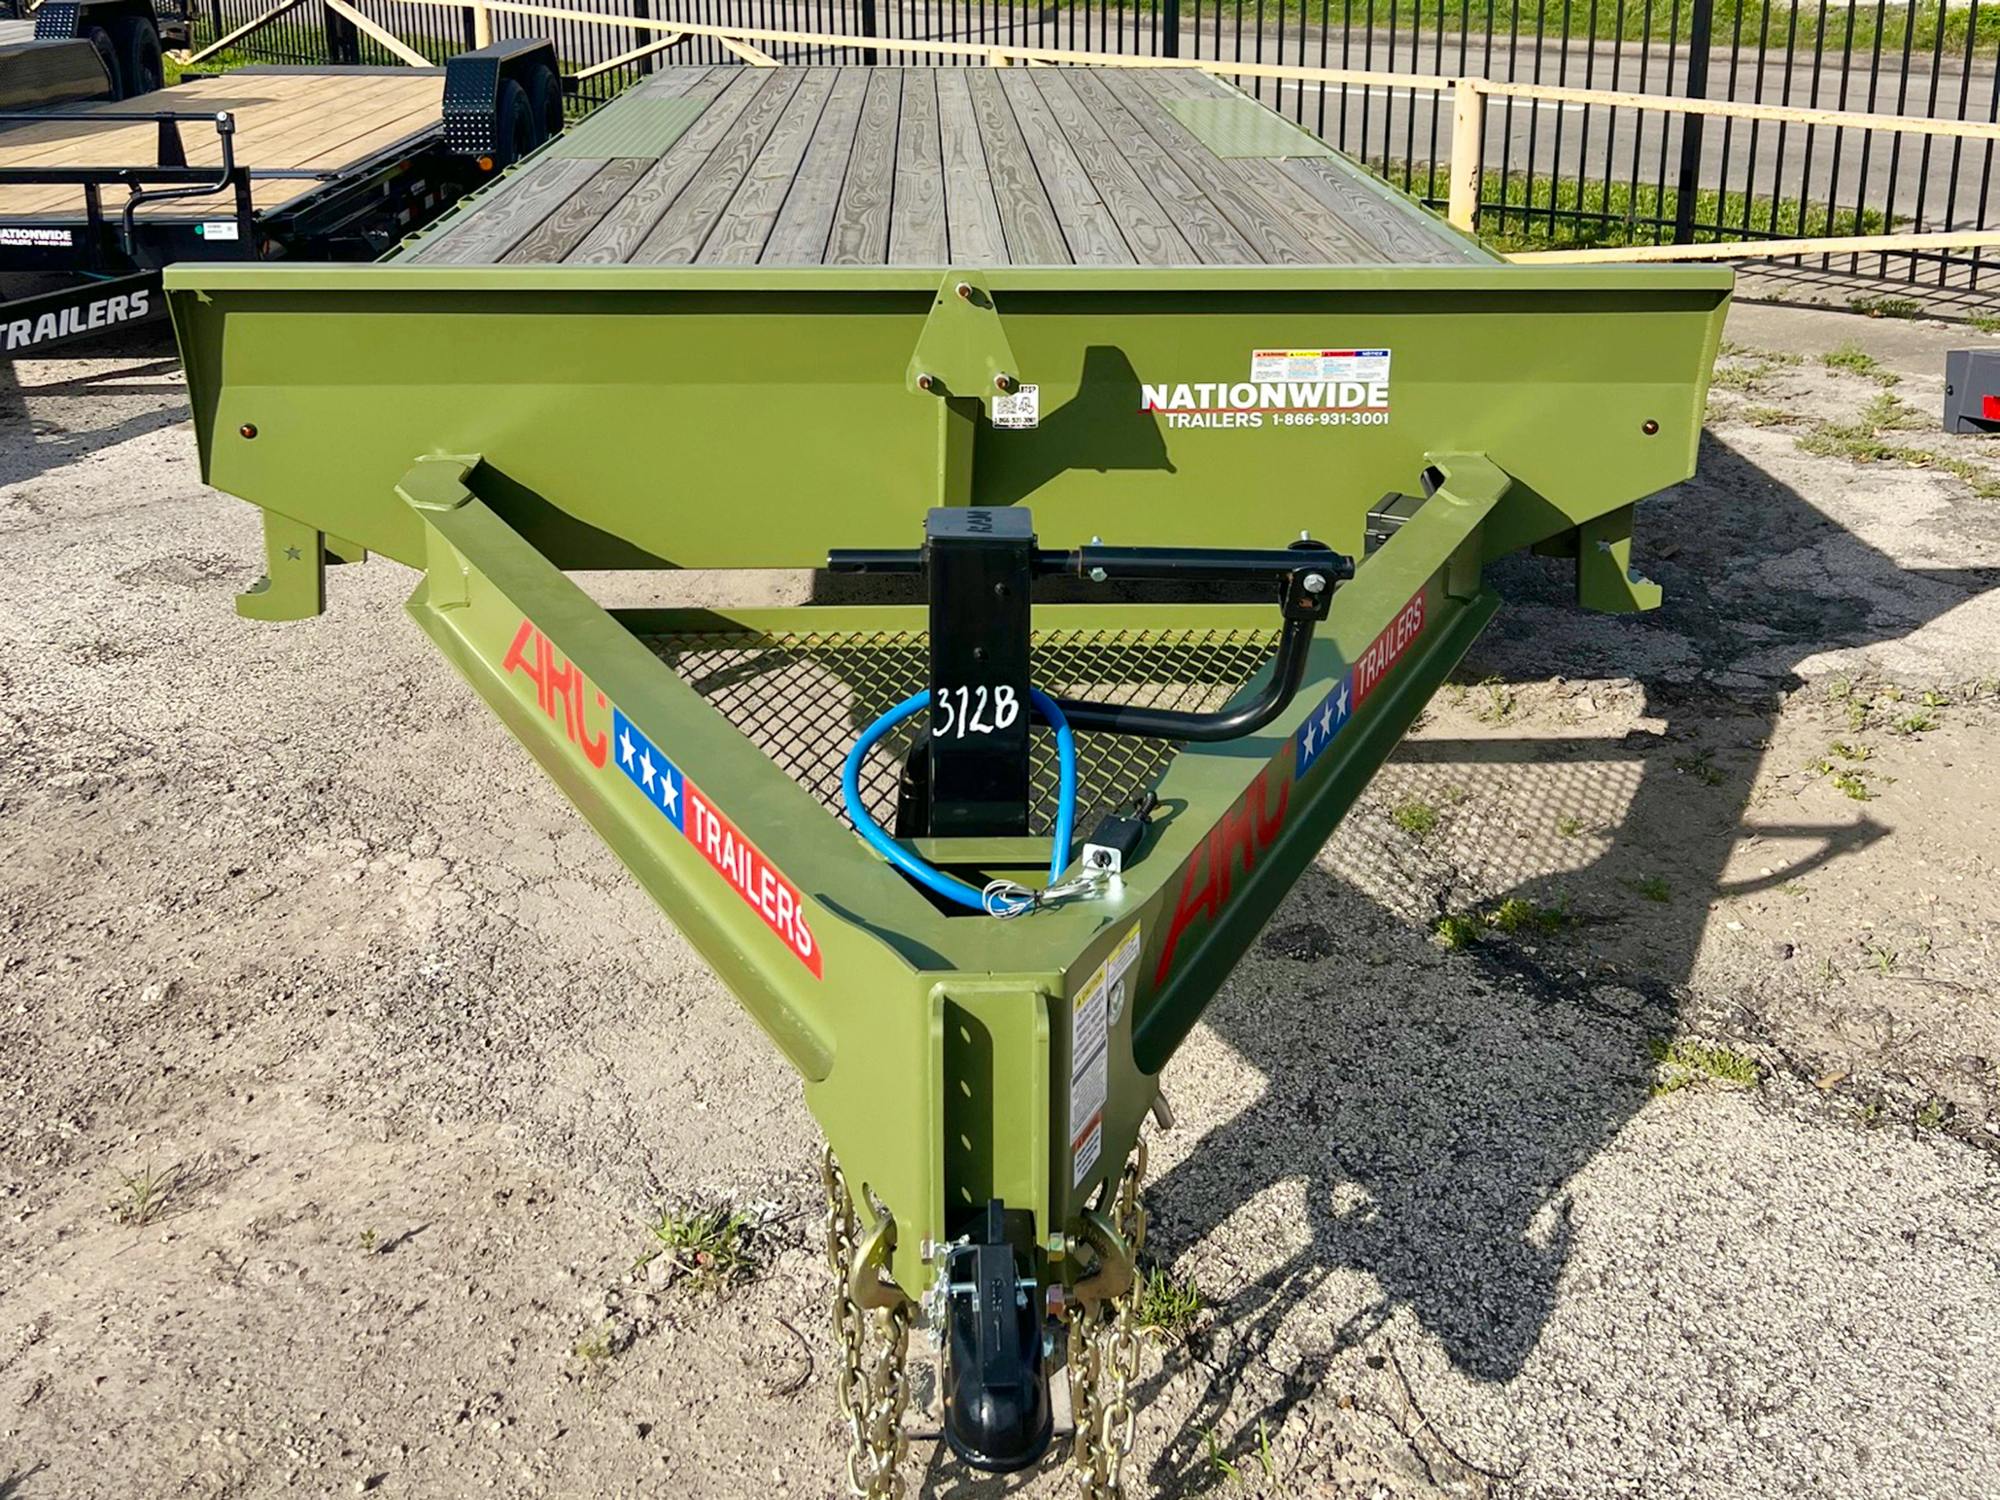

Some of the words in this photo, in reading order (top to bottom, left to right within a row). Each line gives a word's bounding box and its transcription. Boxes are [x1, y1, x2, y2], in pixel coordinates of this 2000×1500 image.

[0, 228, 72, 240] ATIONWIDE
[1142, 382, 1389, 410] NATIONWIDE
[1166, 412, 1263, 428] TRAILERS
[1272, 412, 1389, 426] 1-866-931-3001
[1358, 596, 1424, 697] TRAILERS
[690, 796, 812, 957] TRAILERS
